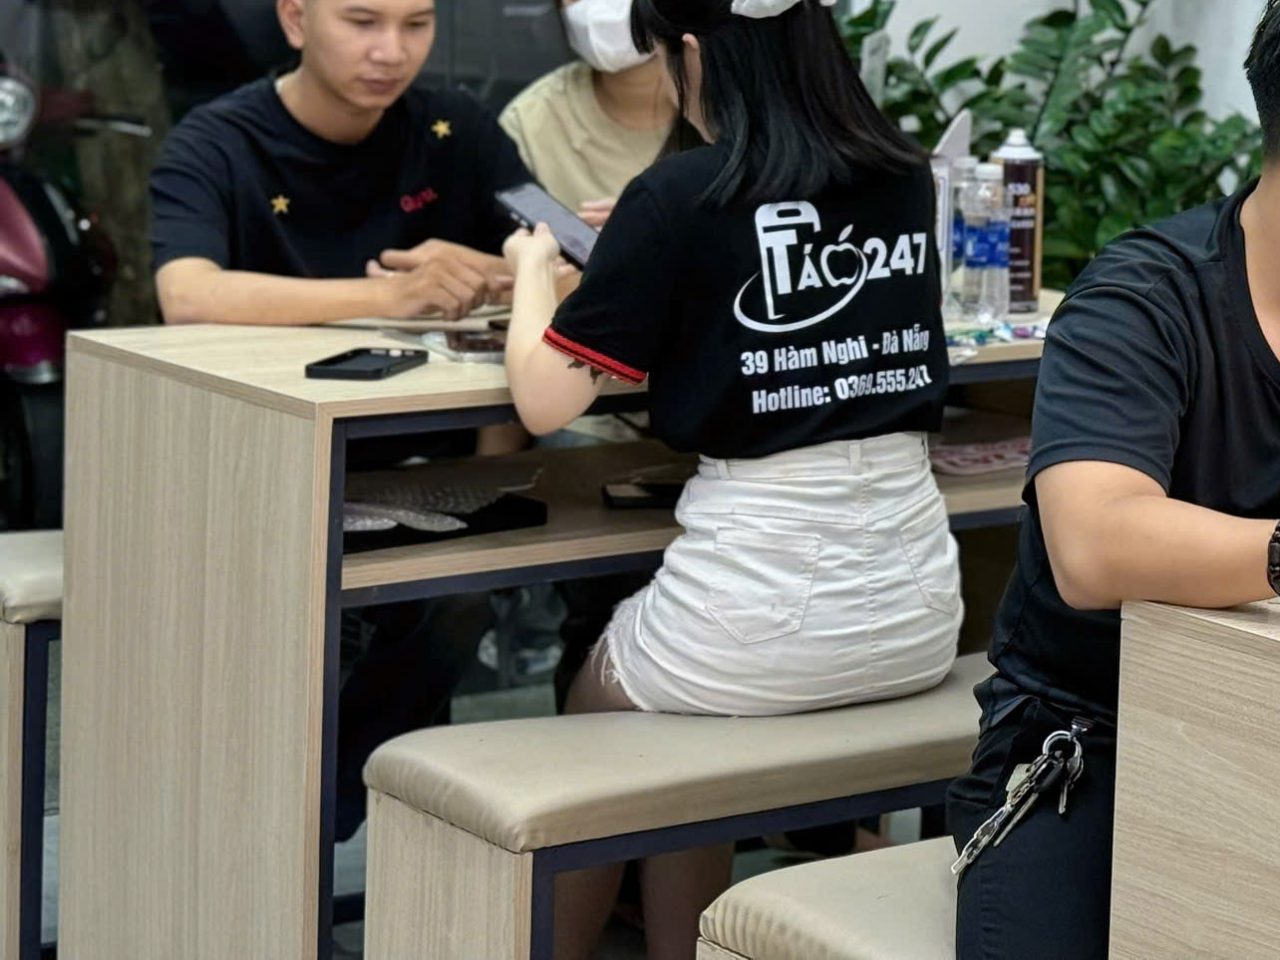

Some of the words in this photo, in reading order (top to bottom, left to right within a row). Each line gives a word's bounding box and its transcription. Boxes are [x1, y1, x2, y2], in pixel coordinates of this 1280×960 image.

[740, 350, 769, 376] 39
[774, 345, 818, 373] Hàm
[822, 335, 869, 366] Nghi
[881, 330, 899, 355] Đà
[752, 385, 832, 415] Hotline:
